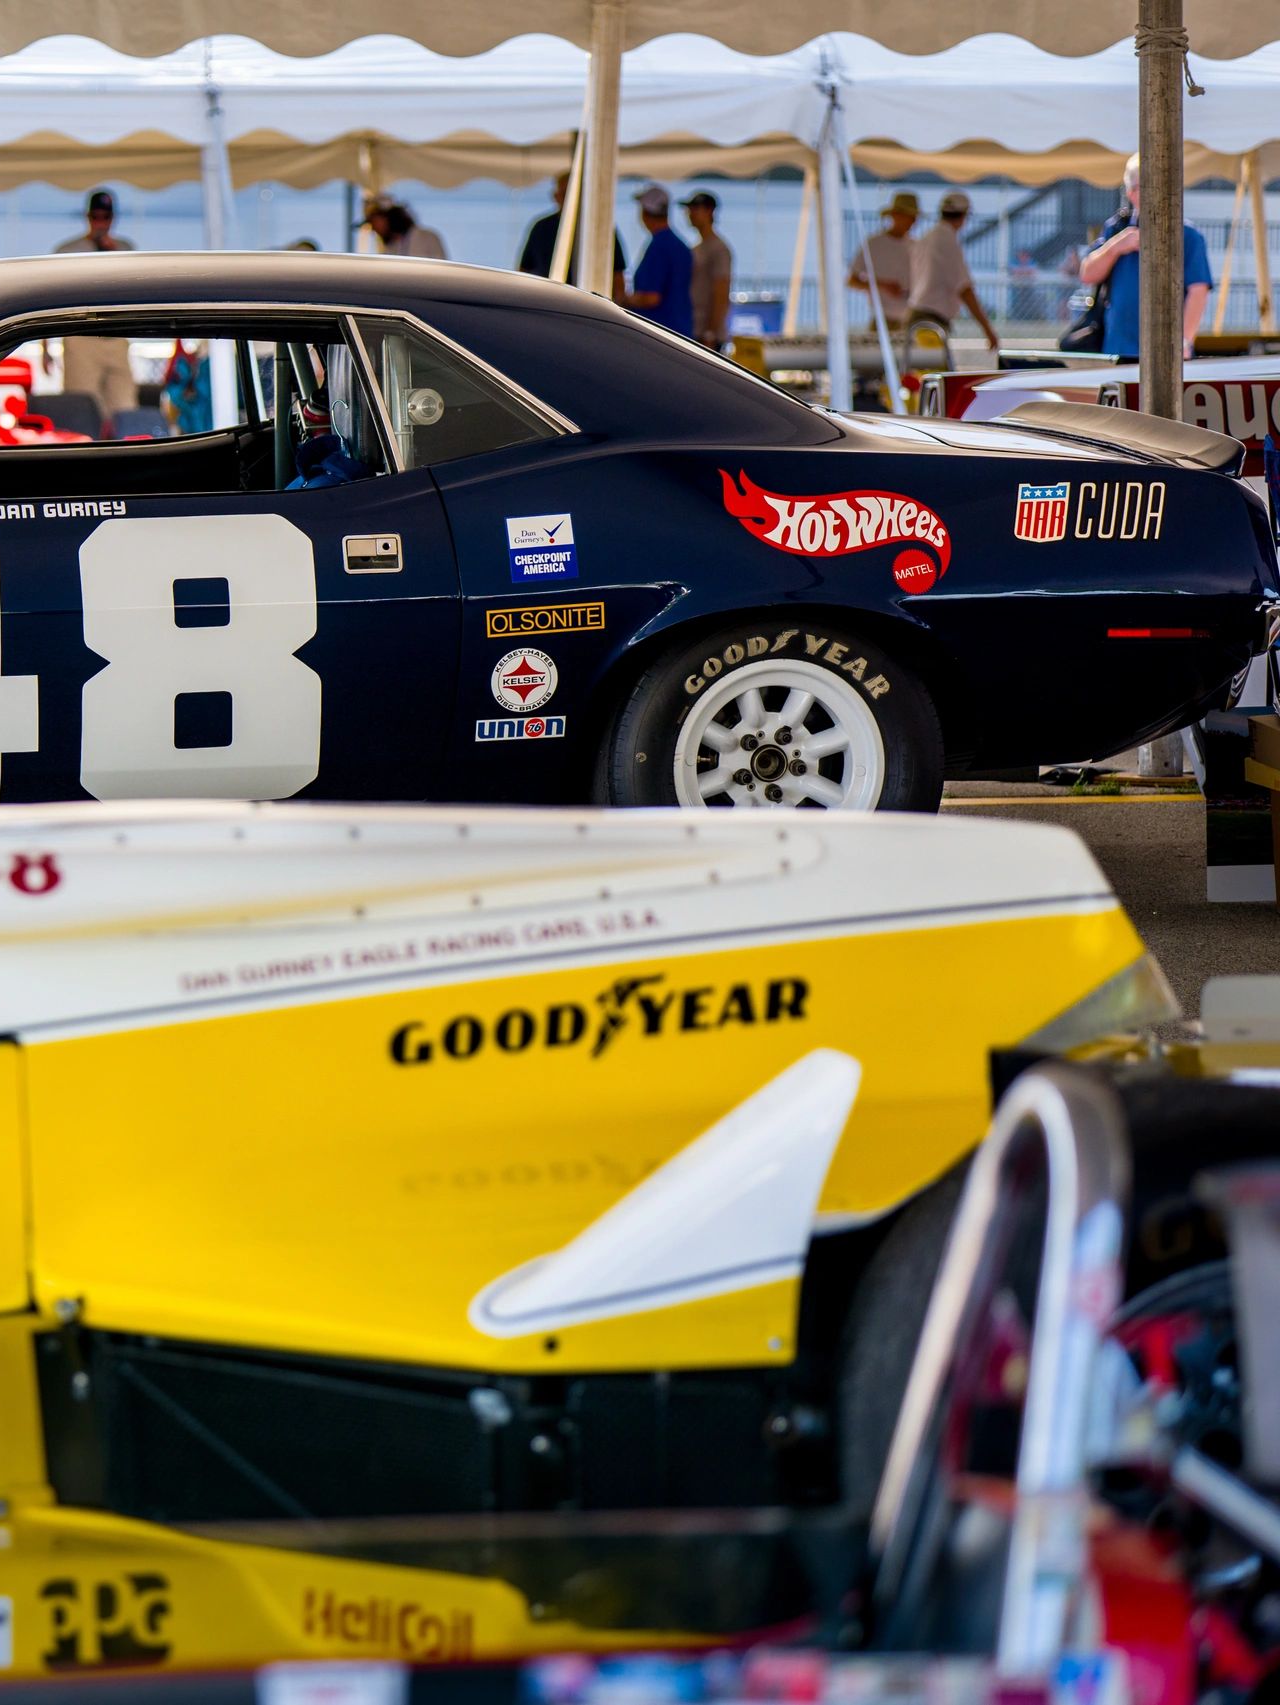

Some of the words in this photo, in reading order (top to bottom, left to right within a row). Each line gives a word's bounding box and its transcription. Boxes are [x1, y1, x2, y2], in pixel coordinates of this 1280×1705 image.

[43, 501, 126, 518] GURNEY
[1016, 501, 1065, 539] AAR
[1074, 482, 1166, 540] CUDA
[514, 536, 544, 545] Gurney's
[514, 551, 571, 566] CHECKPOINT
[523, 563, 565, 575] AMERICA
[894, 563, 933, 580] MATTEL
[491, 607, 601, 632] OLSONITE
[502, 675, 546, 686] KELSEY
